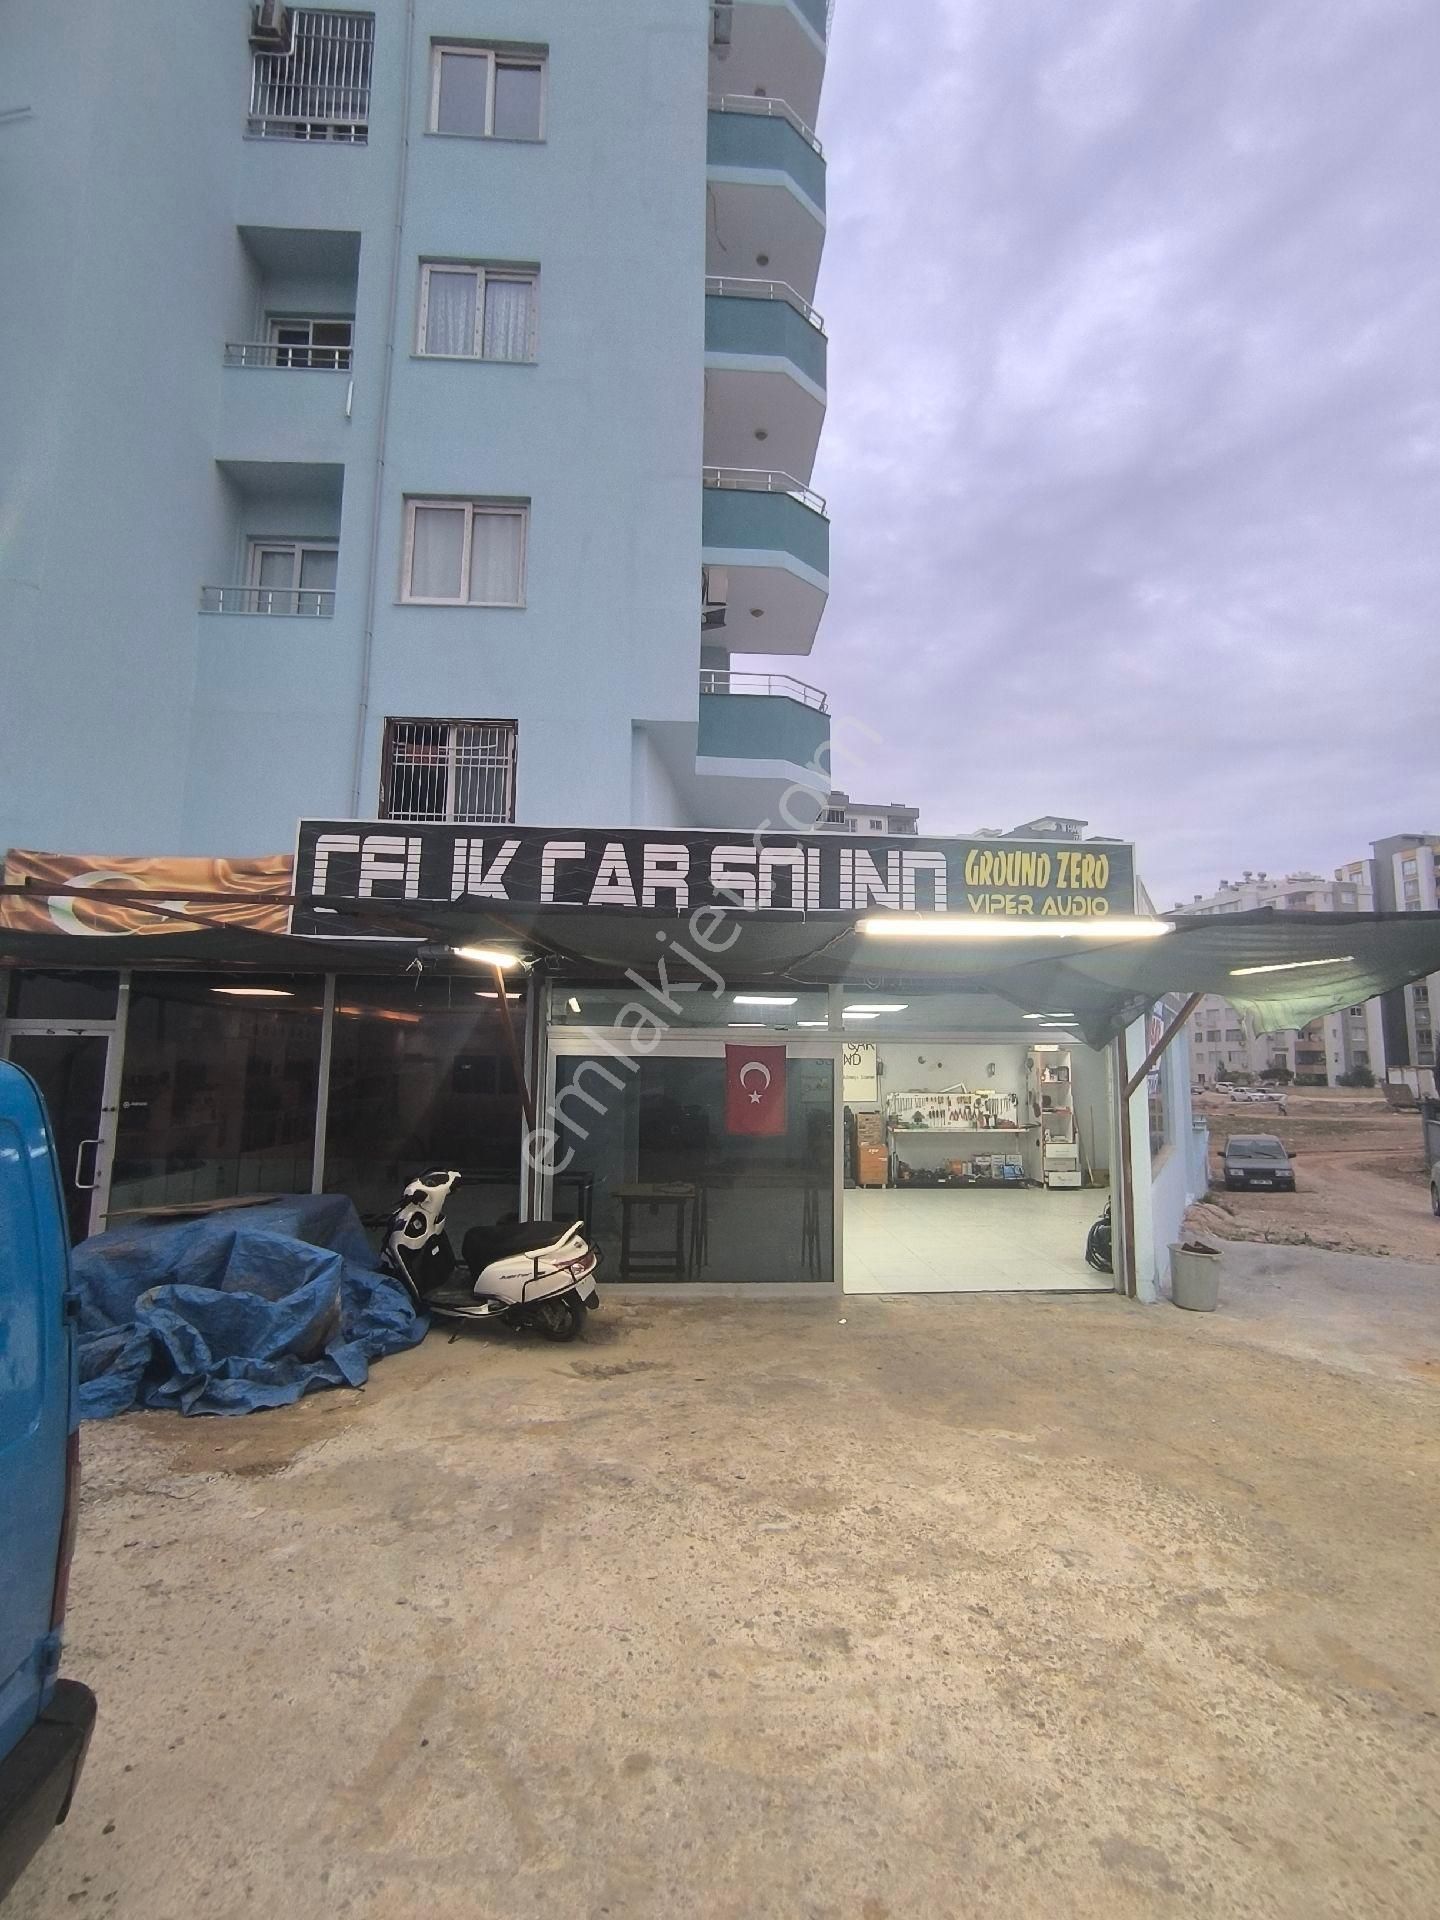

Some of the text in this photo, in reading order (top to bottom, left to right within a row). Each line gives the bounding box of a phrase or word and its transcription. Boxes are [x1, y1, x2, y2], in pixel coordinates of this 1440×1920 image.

[541, 841, 689, 909] CAR
[711, 845, 947, 911] SOUND
[965, 849, 1110, 889] GROUND ZERO
[967, 893, 1110, 916] VIPER AUDIO
